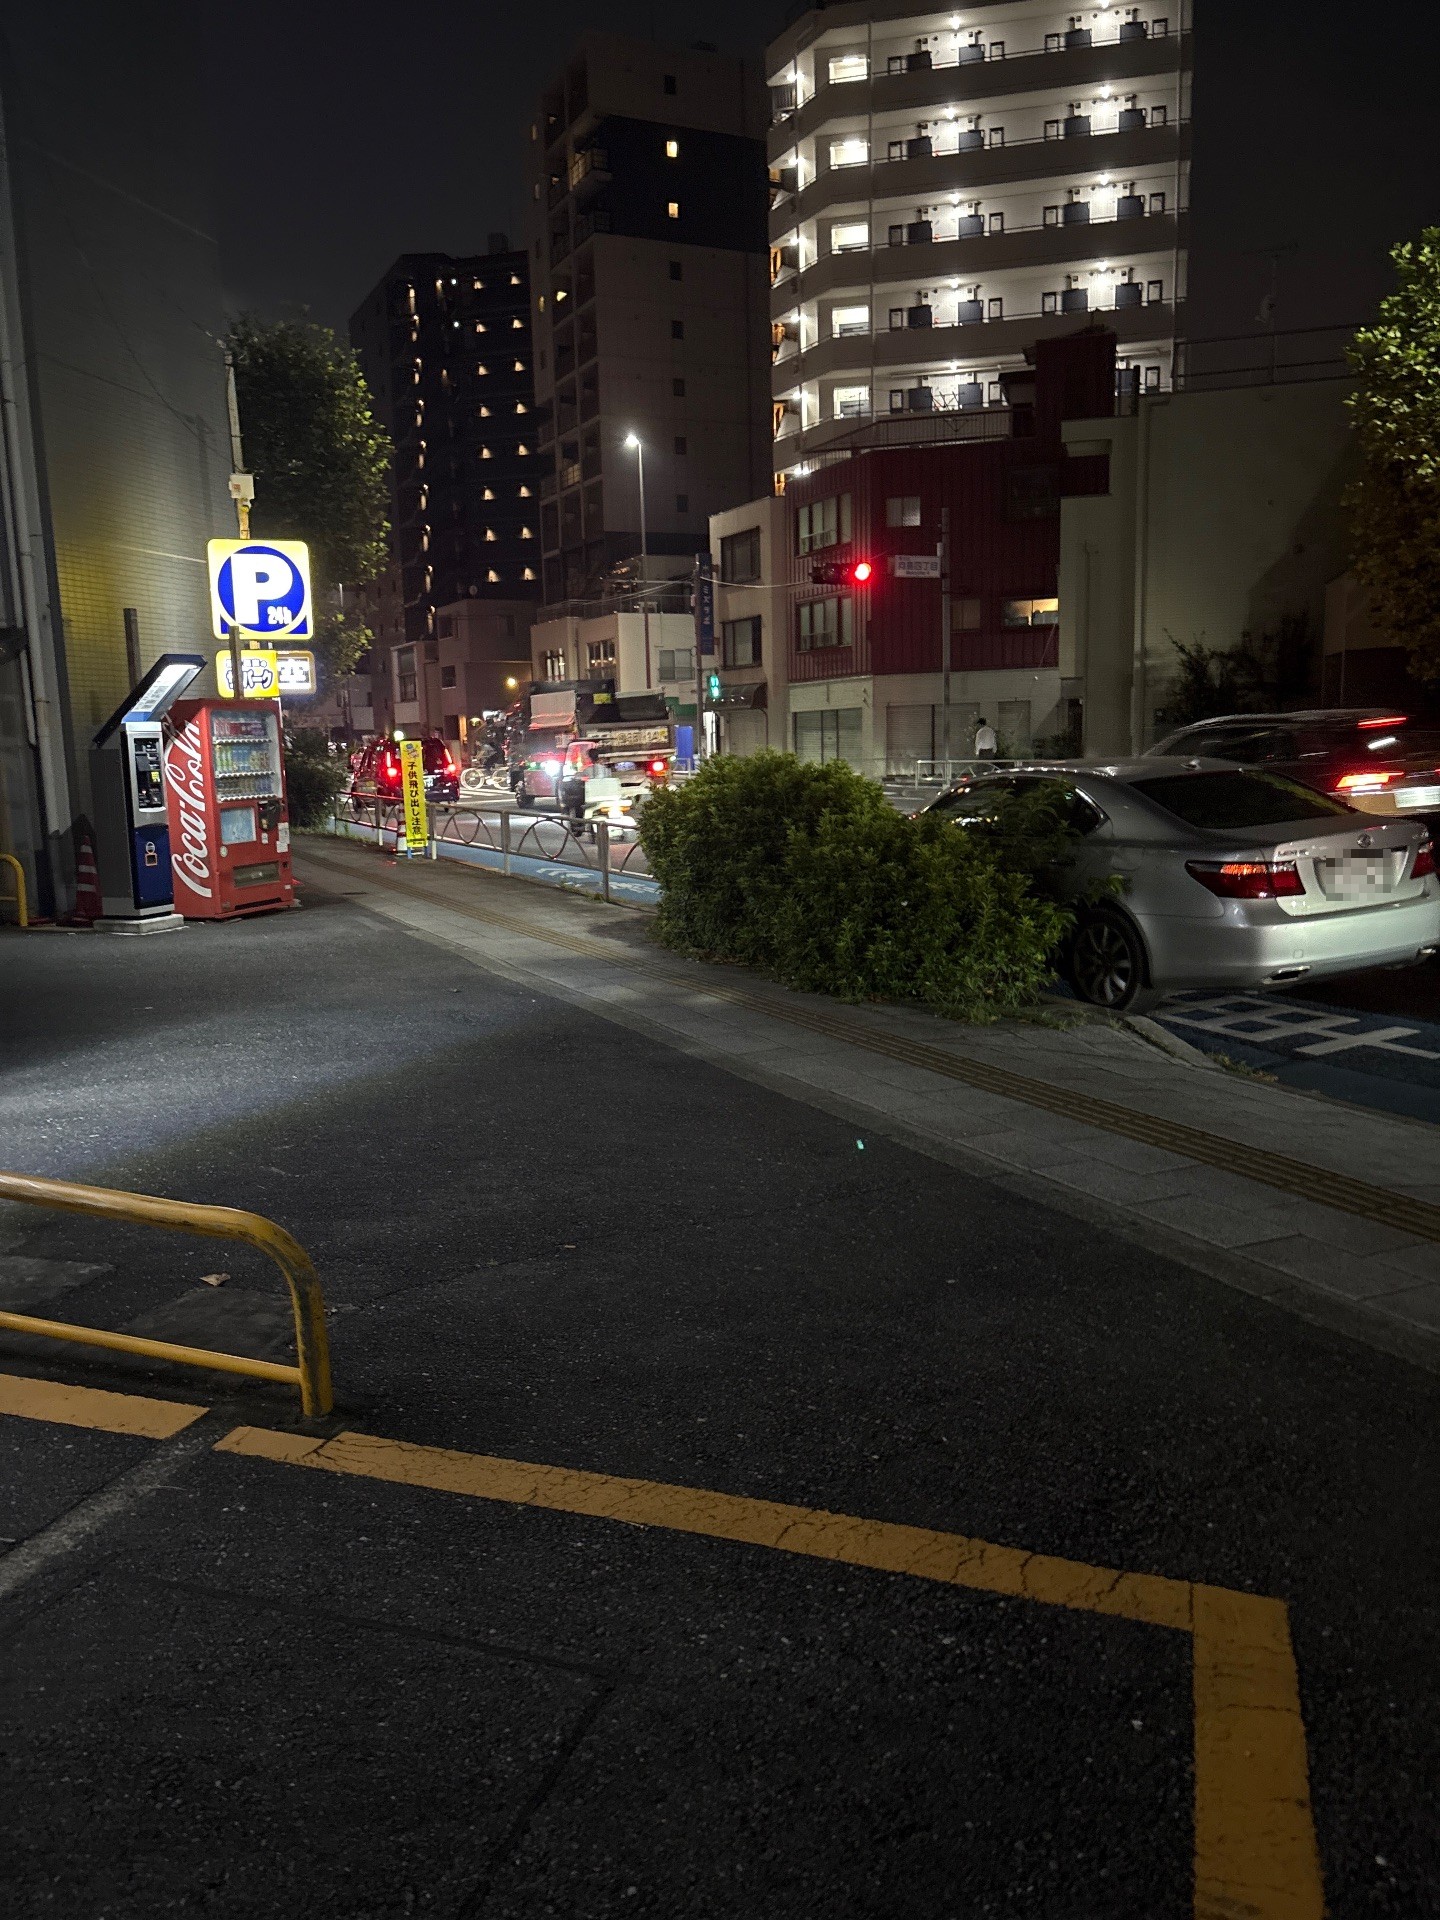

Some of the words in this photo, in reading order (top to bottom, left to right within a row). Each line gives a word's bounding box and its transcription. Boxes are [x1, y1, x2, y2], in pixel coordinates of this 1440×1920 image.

[230, 553, 293, 624] P
[267, 606, 292, 624] 24h
[163, 714, 212, 897] Coca-Cola
[407, 761, 422, 835] 子供飛び出し注意
